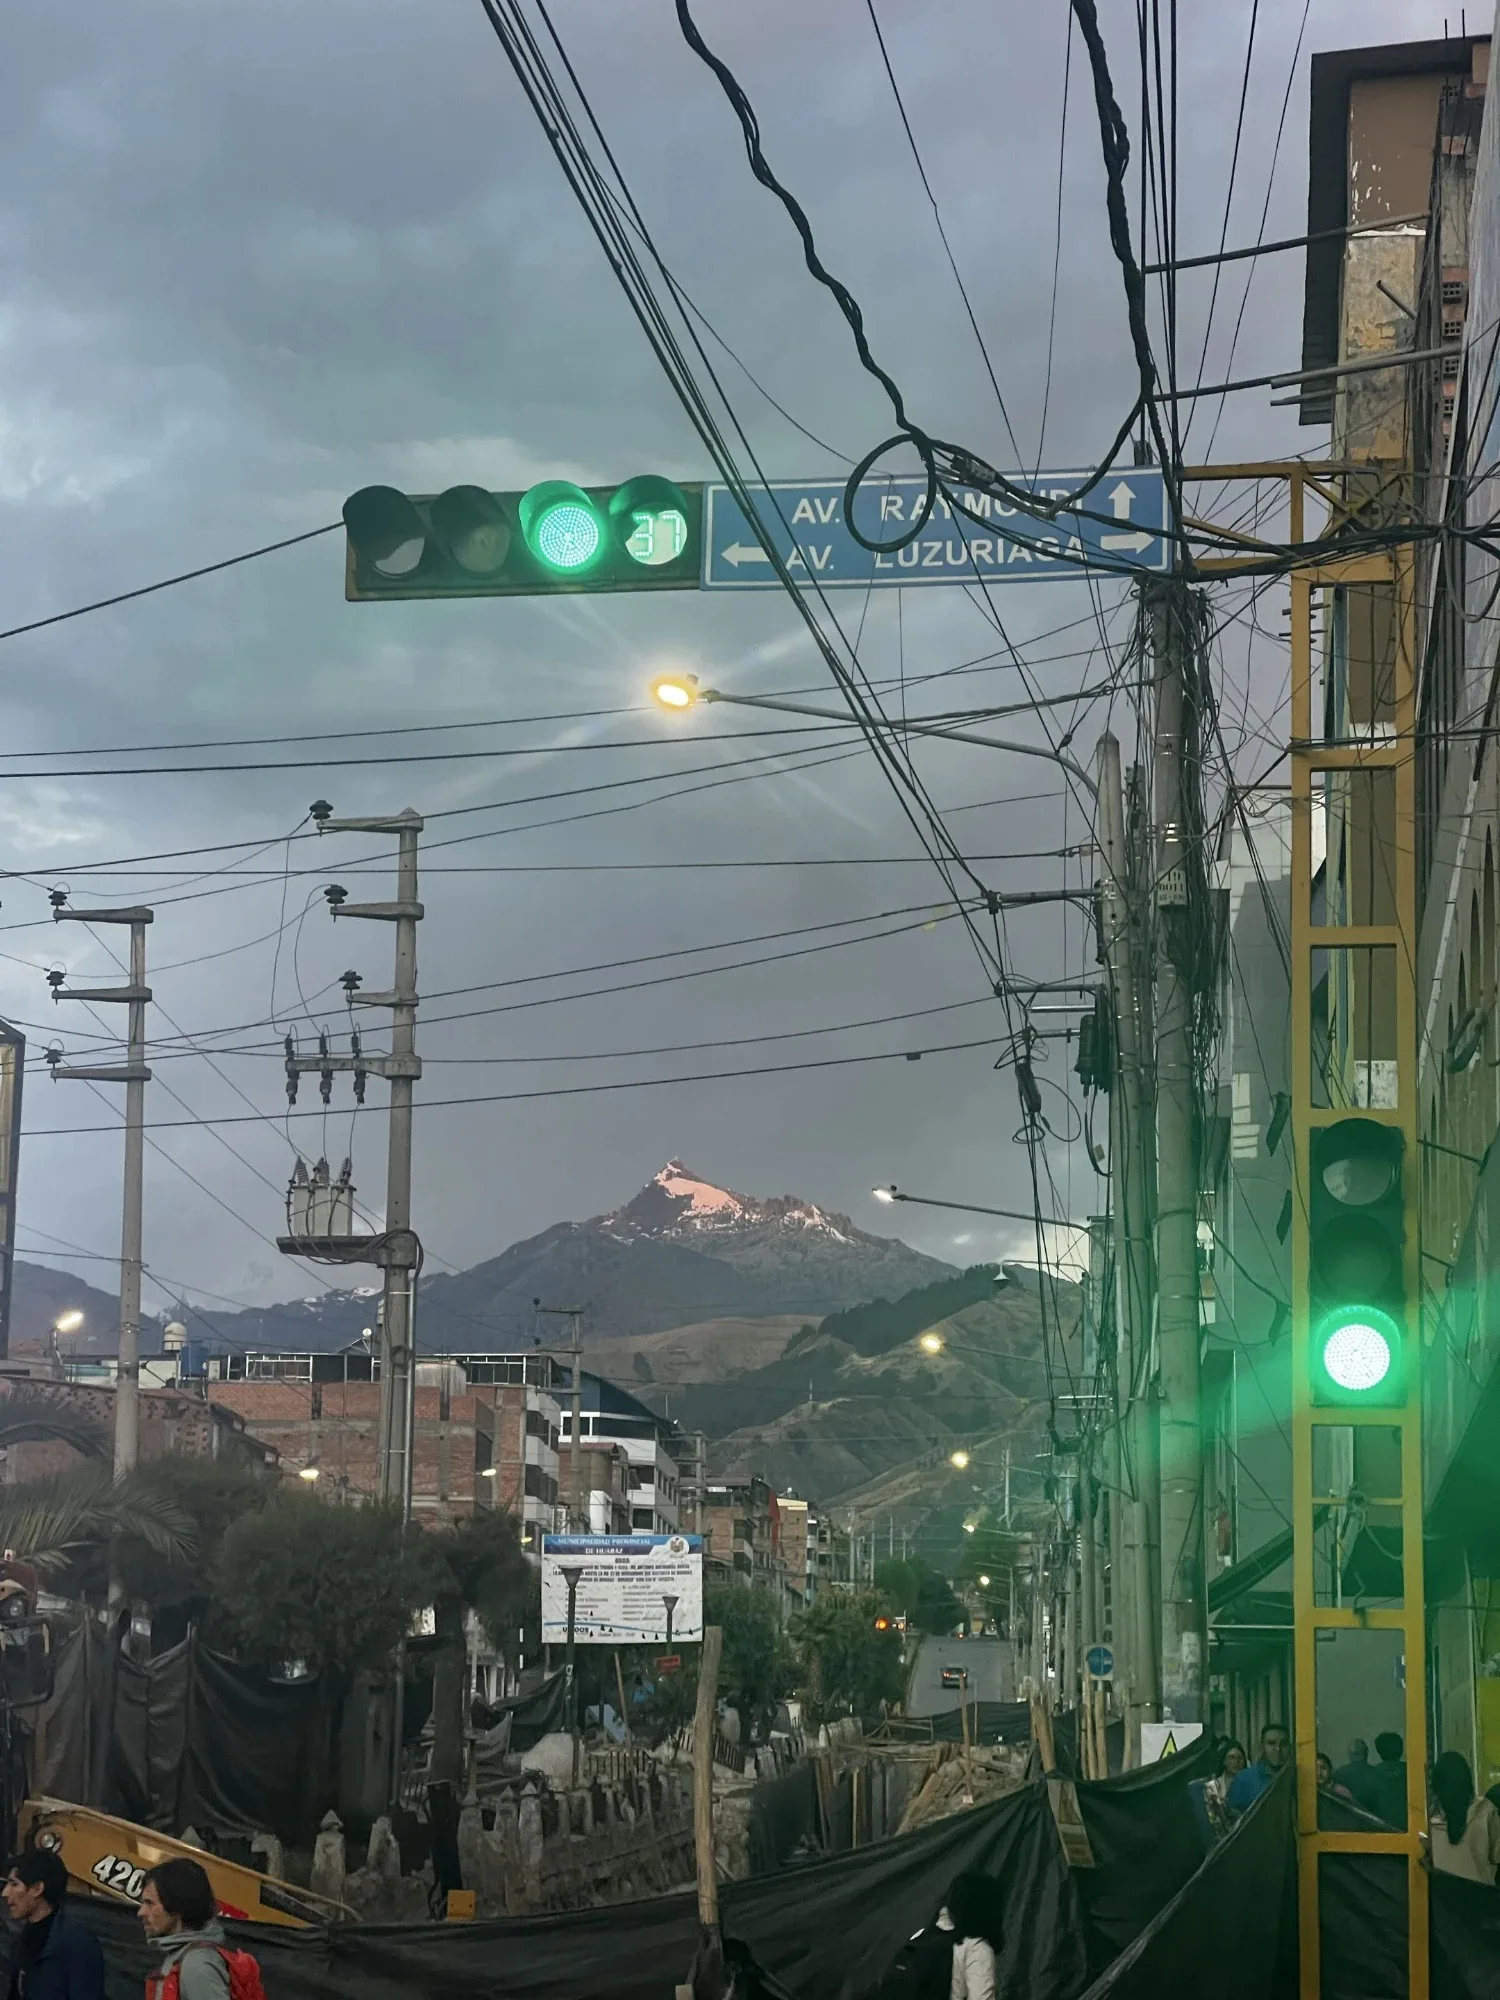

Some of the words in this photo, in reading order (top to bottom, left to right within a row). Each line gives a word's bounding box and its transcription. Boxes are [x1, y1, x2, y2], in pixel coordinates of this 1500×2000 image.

[791, 497, 840, 524] AV.
[634, 514, 681, 556] 37
[785, 544, 835, 570] AV.
[875, 535, 1088, 568] LUZURIAGA
